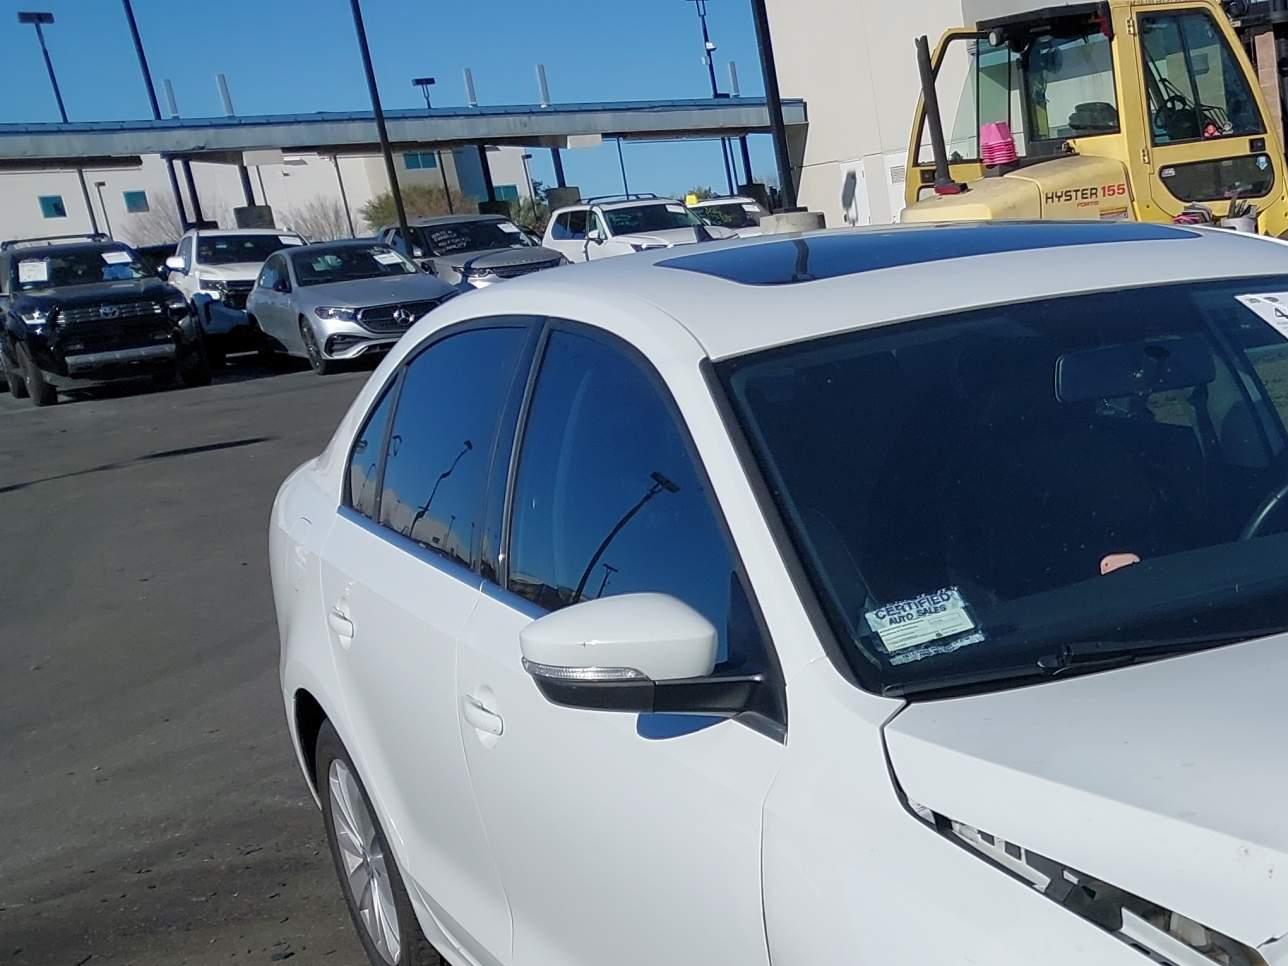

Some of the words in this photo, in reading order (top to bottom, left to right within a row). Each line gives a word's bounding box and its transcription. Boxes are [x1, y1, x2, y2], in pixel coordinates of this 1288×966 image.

[1045, 187, 1098, 204] HYSTER
[1101, 184, 1126, 198] 155
[874, 592, 951, 620] CERTIFIED
[888, 612, 914, 626] AUTO
[916, 604, 947, 617] SALES
